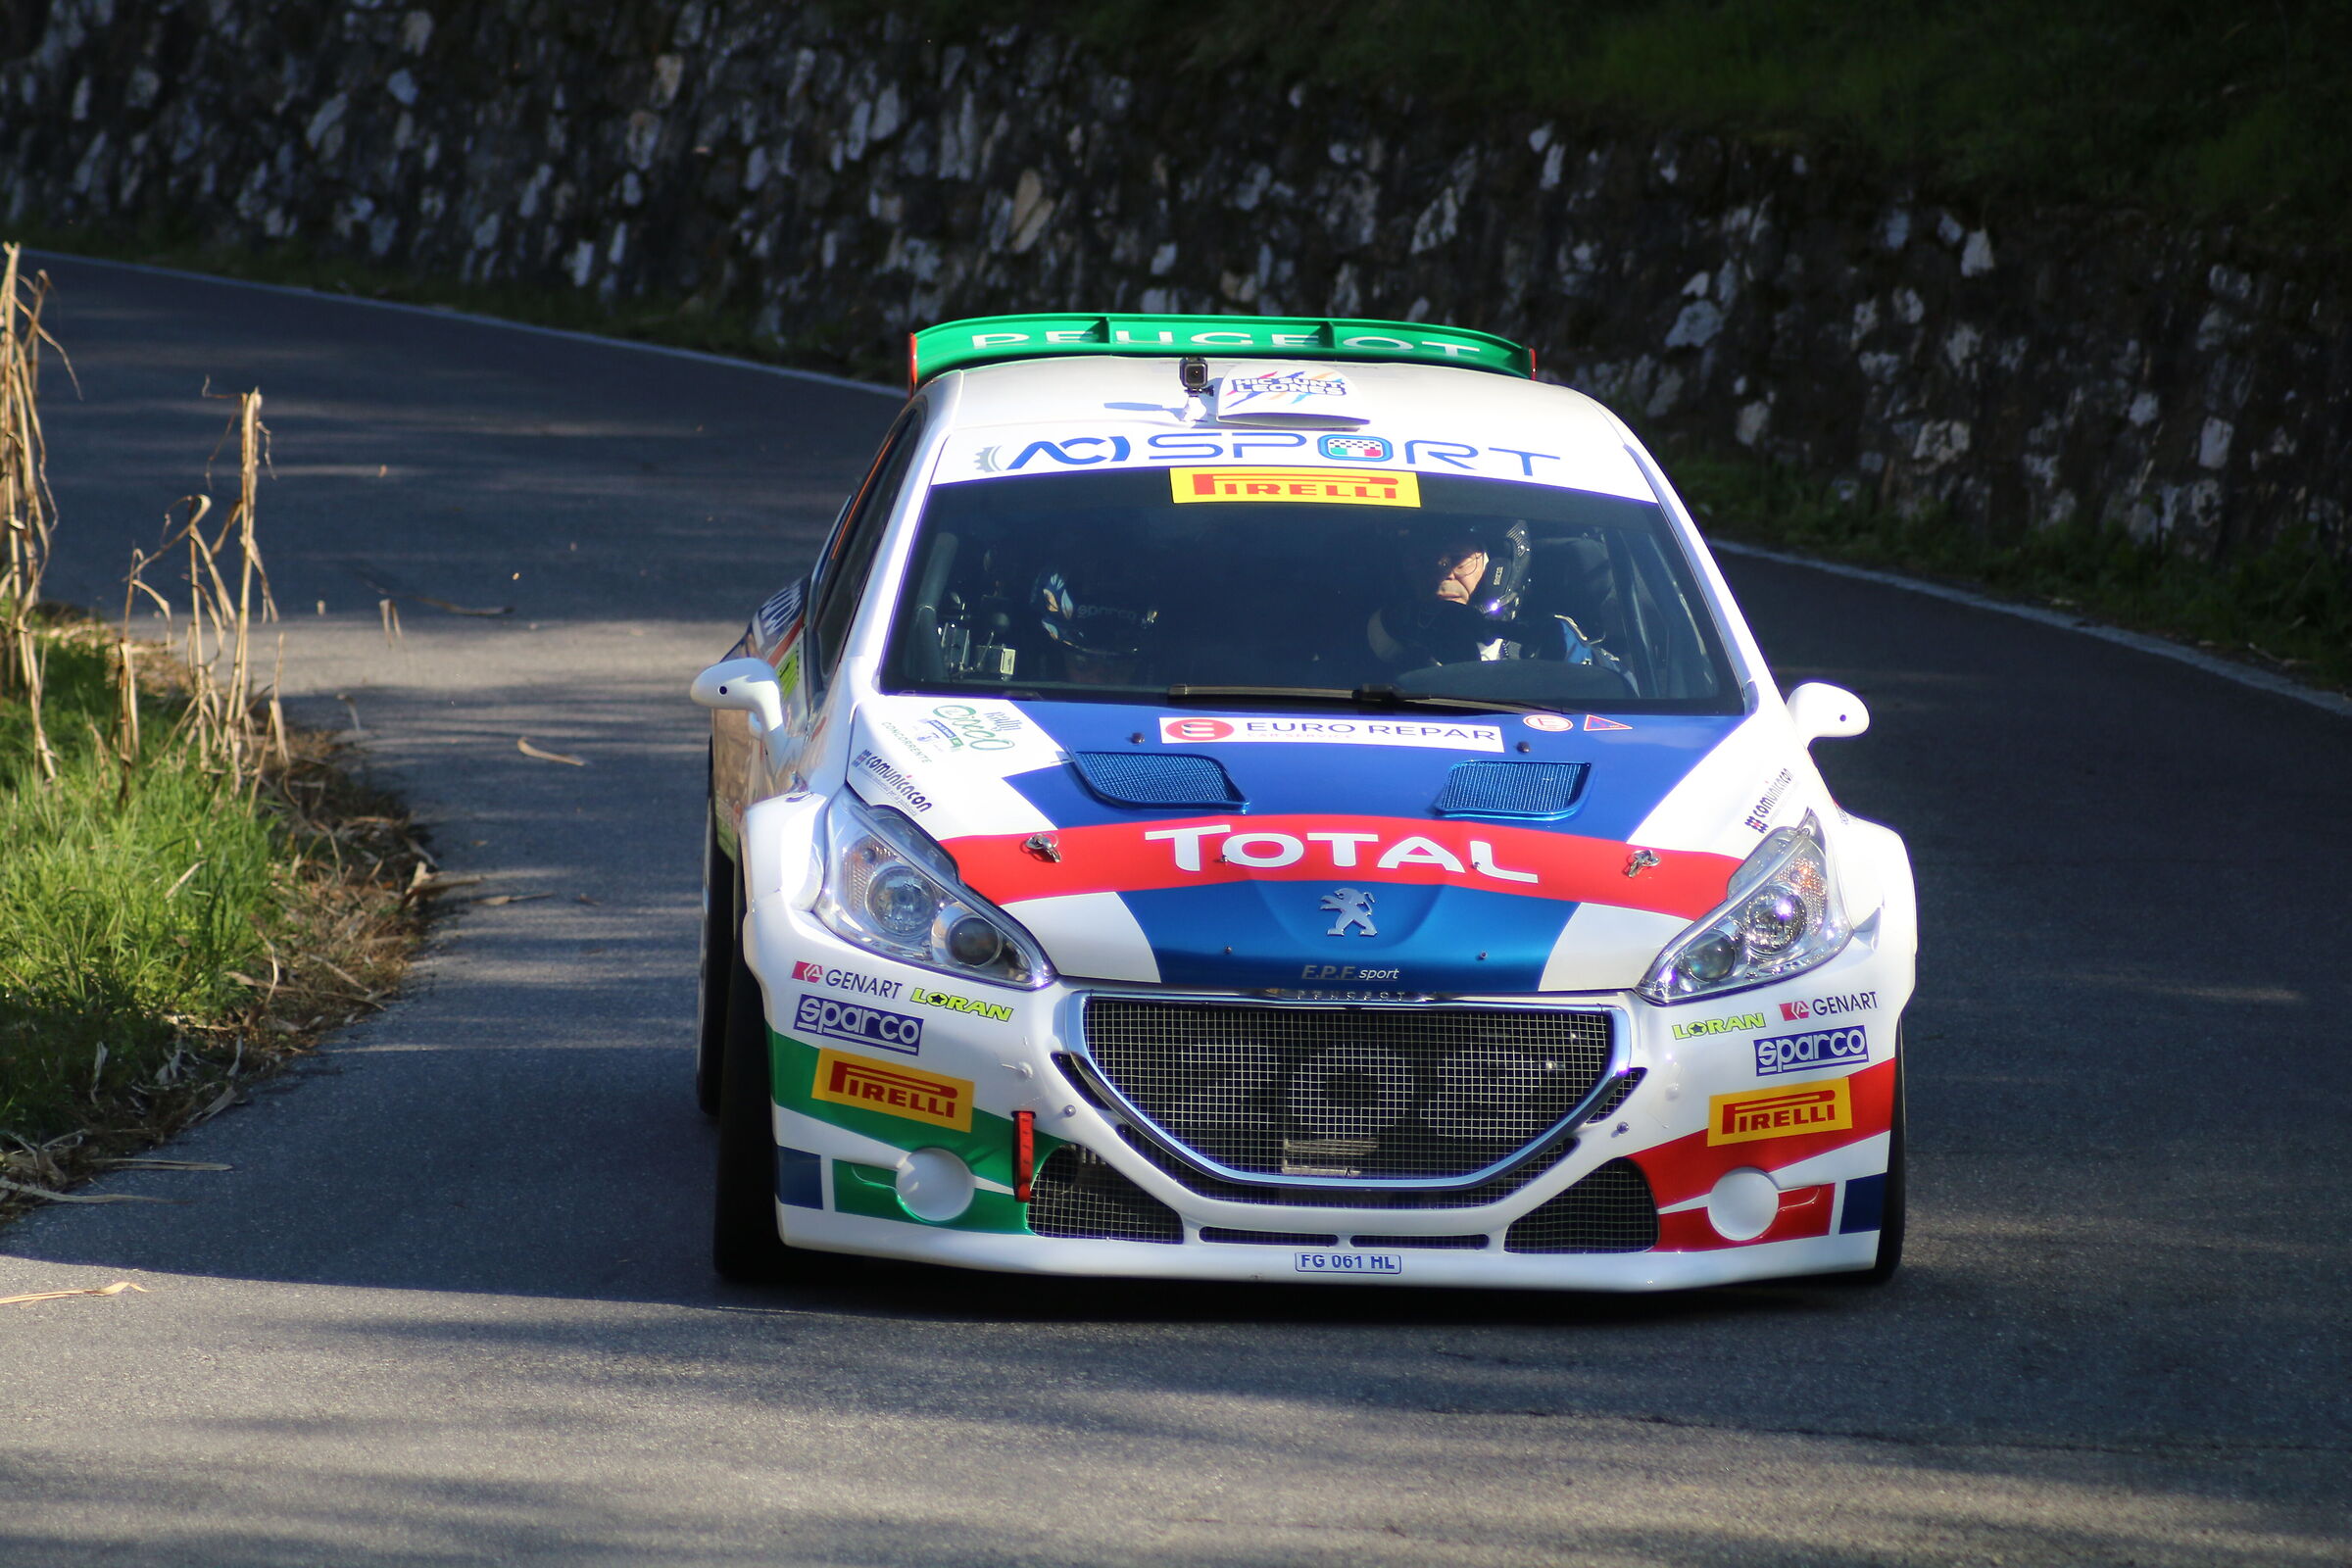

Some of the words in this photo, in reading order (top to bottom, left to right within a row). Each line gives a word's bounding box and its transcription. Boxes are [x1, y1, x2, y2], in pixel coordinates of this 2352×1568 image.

[971, 330, 1480, 359] PEUGEOT
[1236, 383, 1347, 396] LEONES
[1277, 377, 1346, 388] SUNT
[1192, 472, 1399, 500] PIRELLI
[880, 720, 933, 764] CONCORRENTE
[1246, 721, 1356, 734] EURO
[1368, 723, 1496, 742] REPAR
[1145, 824, 1539, 884] TOTAL
[825, 968, 903, 1000] GENART
[1358, 968, 1400, 981] sport
[909, 987, 1014, 1022] LORAN
[1812, 991, 1878, 1016] GENART
[800, 997, 920, 1045] sparco
[1673, 1012, 1767, 1041] LORAN
[1758, 1029, 1866, 1073] sparco
[828, 1059, 958, 1118] PIRELLI
[1722, 1089, 1837, 1135] PIRELLI
[1300, 1253, 1326, 1269] FG
[1330, 1253, 1364, 1270] 061
[1370, 1254, 1396, 1270] HL
